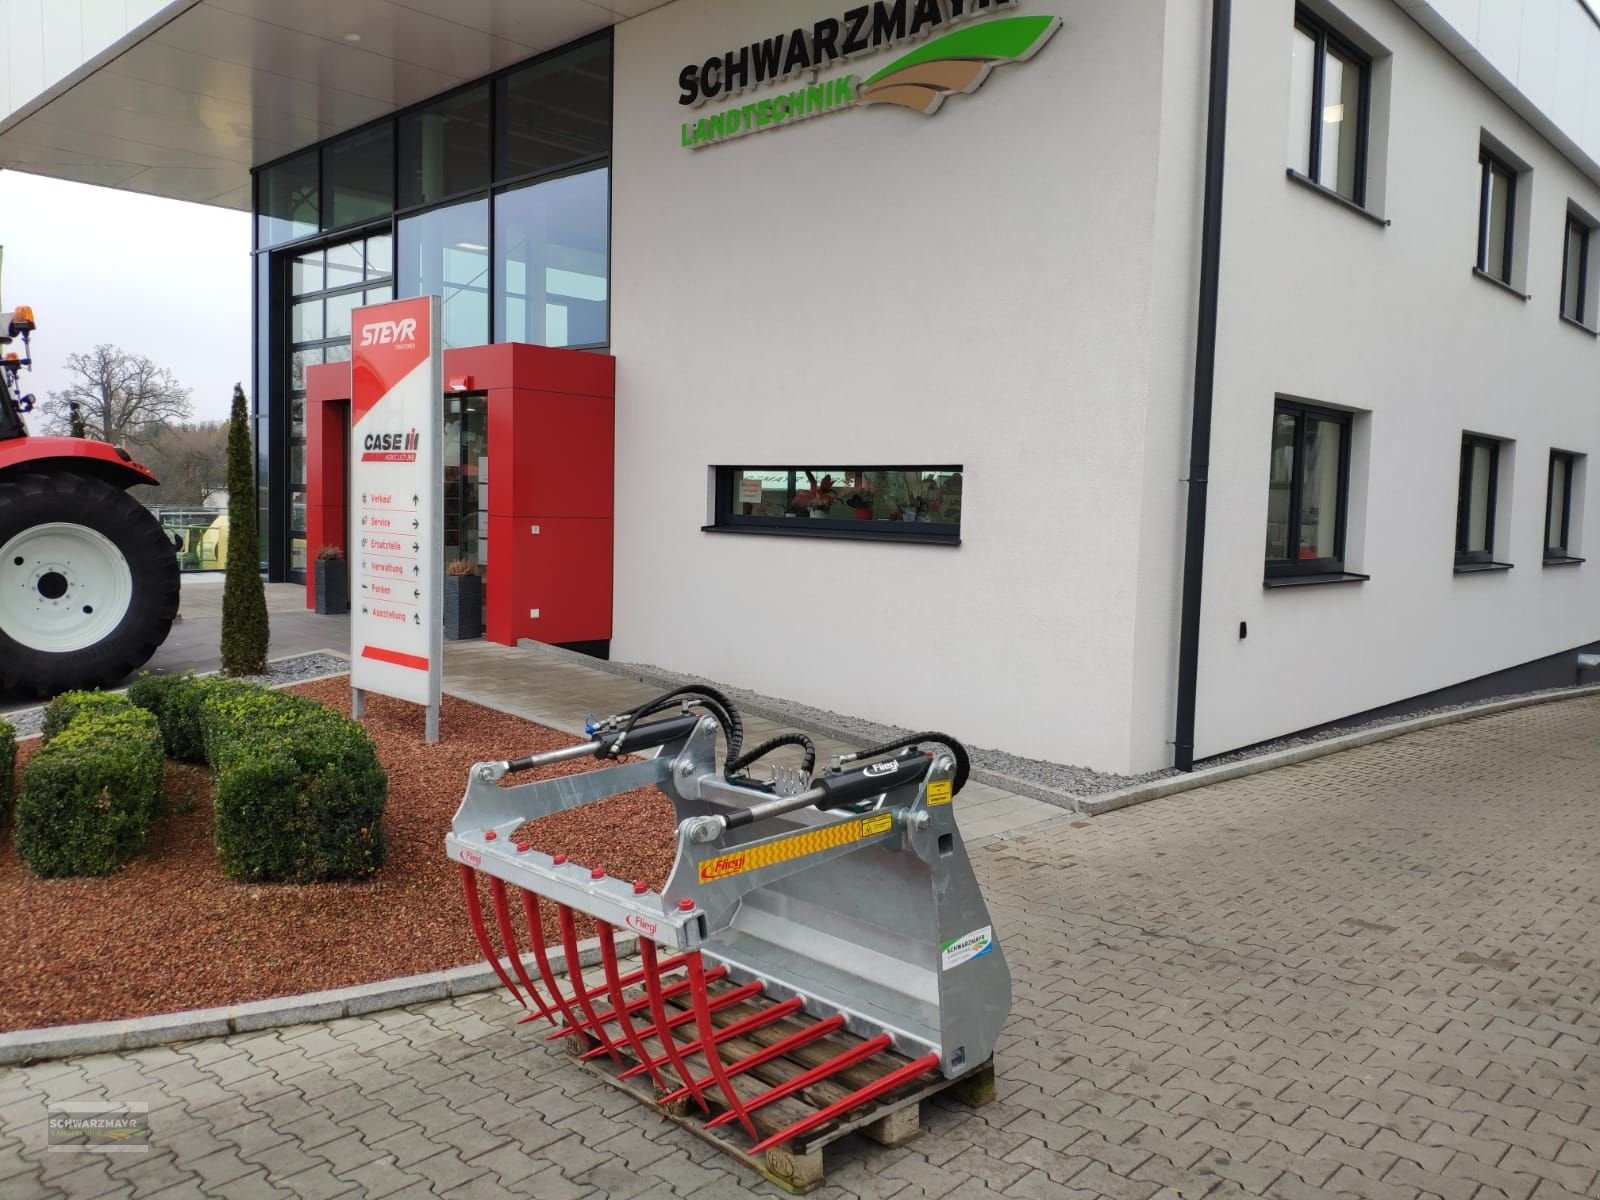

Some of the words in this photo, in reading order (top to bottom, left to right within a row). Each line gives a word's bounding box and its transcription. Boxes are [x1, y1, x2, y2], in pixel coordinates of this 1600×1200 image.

[678, 0, 1012, 106] SCHWARZMA
[680, 74, 856, 147] LANDTECHNIK
[360, 318, 417, 347] STEYR
[364, 433, 403, 451] CASE
[370, 493, 392, 504] Verkauf
[370, 517, 391, 528] Service
[370, 539, 401, 551] Ersatzteile
[371, 561, 403, 576] Verwaltung
[371, 583, 391, 595] Parken
[372, 607, 406, 623] Ausstellung
[872, 759, 899, 773] Fliegl
[714, 853, 746, 873] Fliegl
[635, 916, 657, 936] Fliegl
